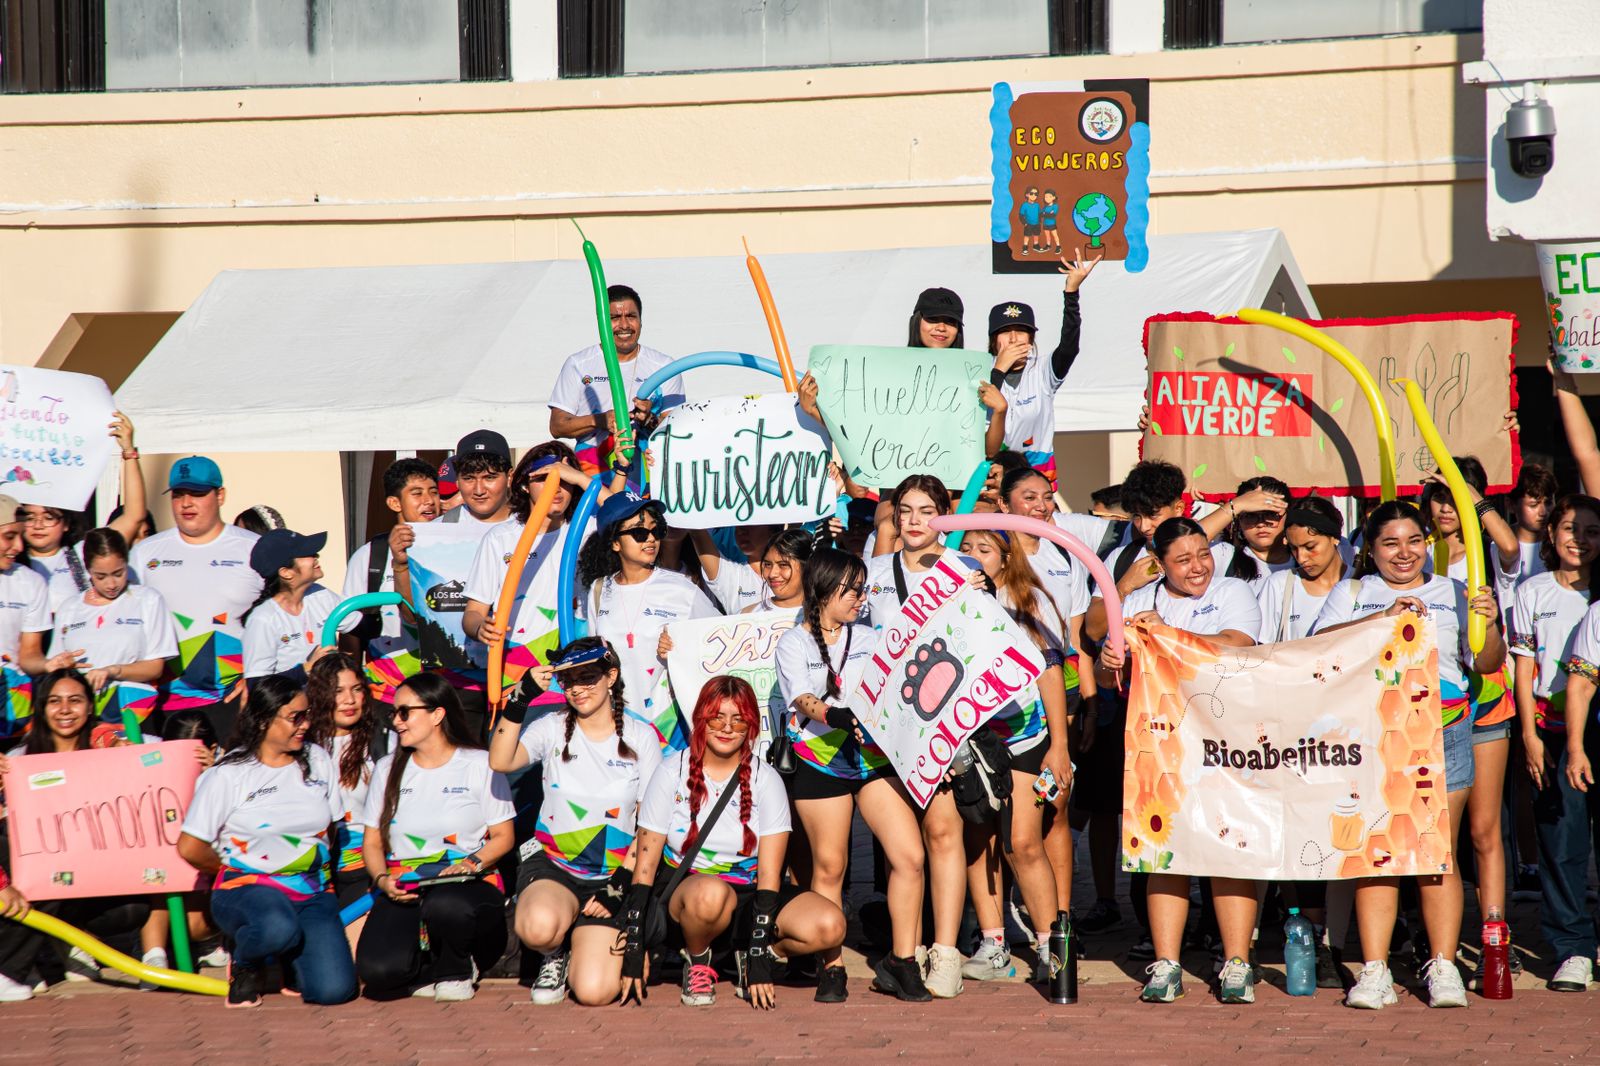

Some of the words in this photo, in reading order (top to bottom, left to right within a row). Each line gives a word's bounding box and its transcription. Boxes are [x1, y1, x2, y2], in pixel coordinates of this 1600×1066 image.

[1015, 126, 1056, 146] ECO
[1015, 151, 1124, 172] VIAJEROS
[829, 356, 961, 419] Huella
[1156, 374, 1306, 408] ALIANZA
[1181, 406, 1276, 437] VERDE
[433, 591, 449, 599] LOS
[1202, 737, 1362, 777] Bioabejitas
